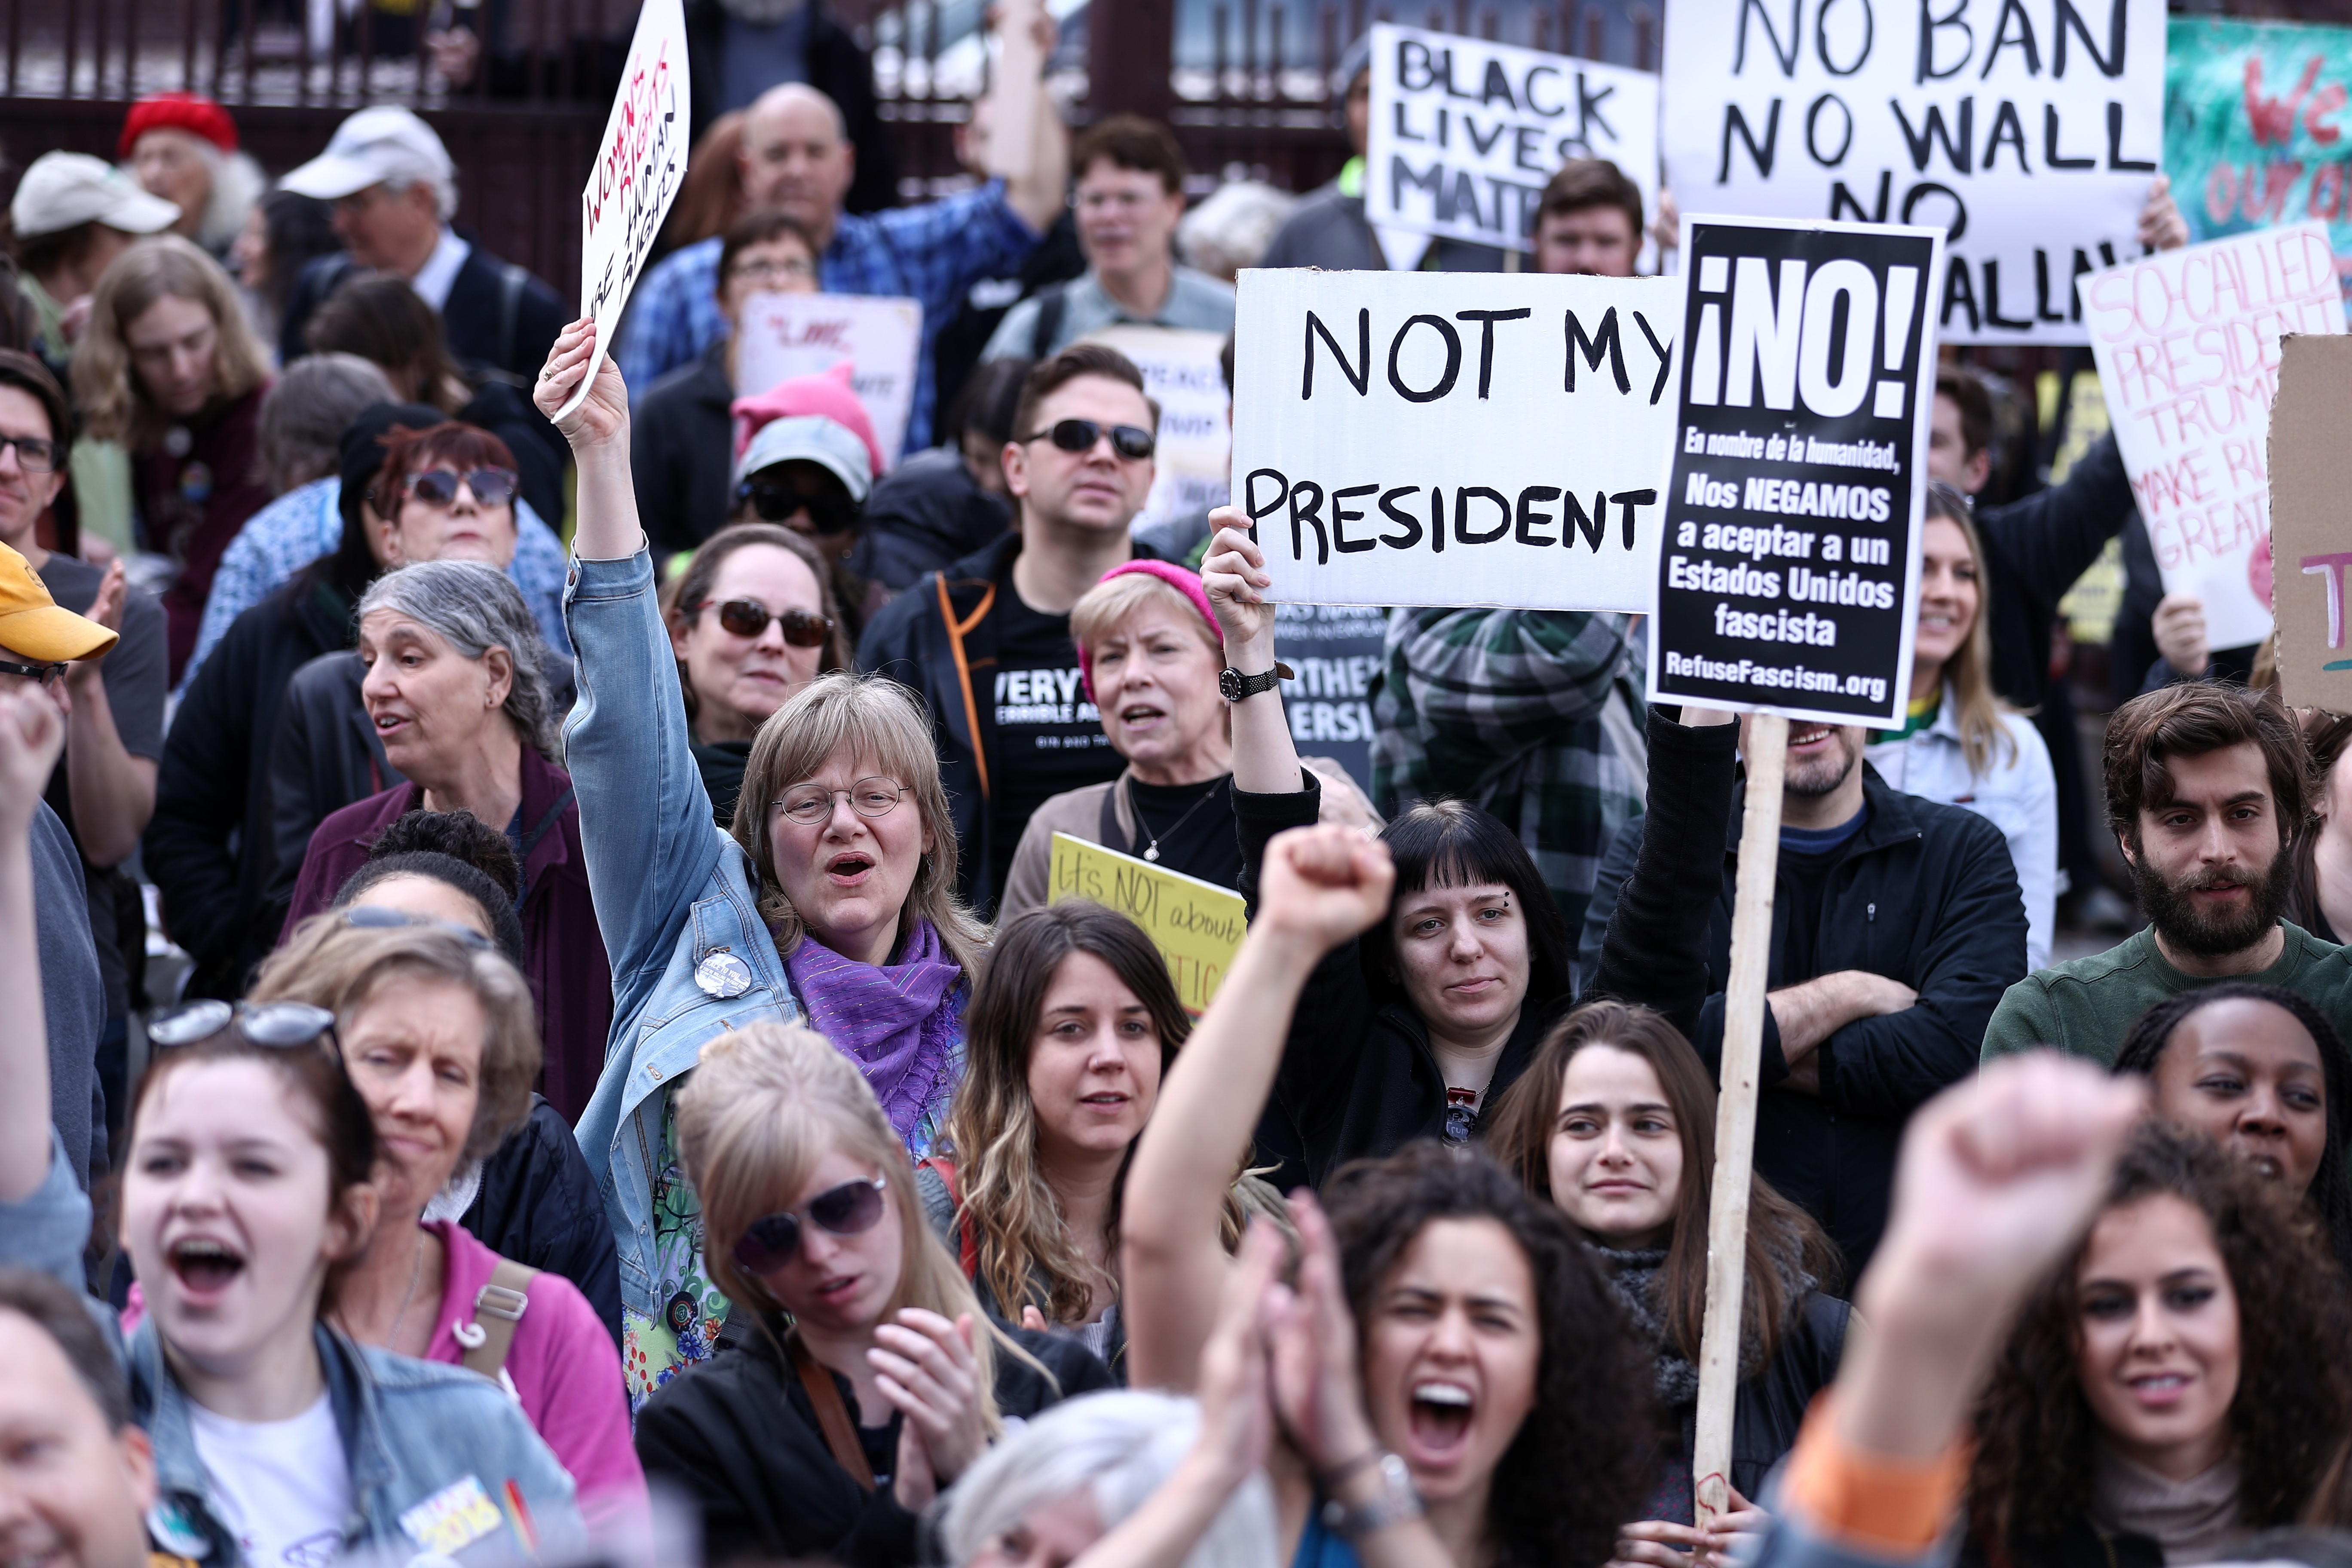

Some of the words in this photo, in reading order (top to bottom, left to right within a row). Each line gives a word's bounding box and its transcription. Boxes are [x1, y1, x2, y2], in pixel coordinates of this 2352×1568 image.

[1732, 0, 1874, 77] NO
[1915, 0, 2126, 84] BAN
[1396, 39, 1618, 142] BLACK
[624, 82, 675, 251] HUMAN
[1716, 93, 1852, 184] NO
[1890, 96, 2156, 175] WALL
[1831, 170, 1967, 243] NO
[1301, 306, 1532, 403] NOT
[1564, 305, 1673, 407] MY
[1689, 256, 1919, 420] ¡NO!
[2134, 373, 2277, 449] TRUM
[1684, 426, 1706, 454] En
[1706, 430, 1765, 459] nombre
[1765, 432, 1787, 461] de
[1787, 434, 1805, 463] la
[1805, 435, 1901, 476] humanidad,
[2132, 448, 2217, 514] MAKE
[1245, 468, 1659, 566] PRESIDENT
[1684, 472, 1739, 508] Nos
[1743, 476, 1891, 523] NEGAMOS
[2150, 488, 2268, 571] GREAT
[1677, 521, 1697, 548] a
[1702, 523, 1815, 561] aceptar
[1822, 534, 1843, 561] a
[1850, 536, 1890, 565] un
[1668, 555, 1781, 599] Estados
[1787, 567, 1895, 609] Unidos
[1715, 603, 1836, 647] fascista
[1666, 651, 1887, 703] RefuseFascism.org
[1115, 866, 1175, 927] NOT
[1170, 900, 1241, 943] about
[701, 958, 720, 971] PEACE
[720, 966, 729, 974] TO
